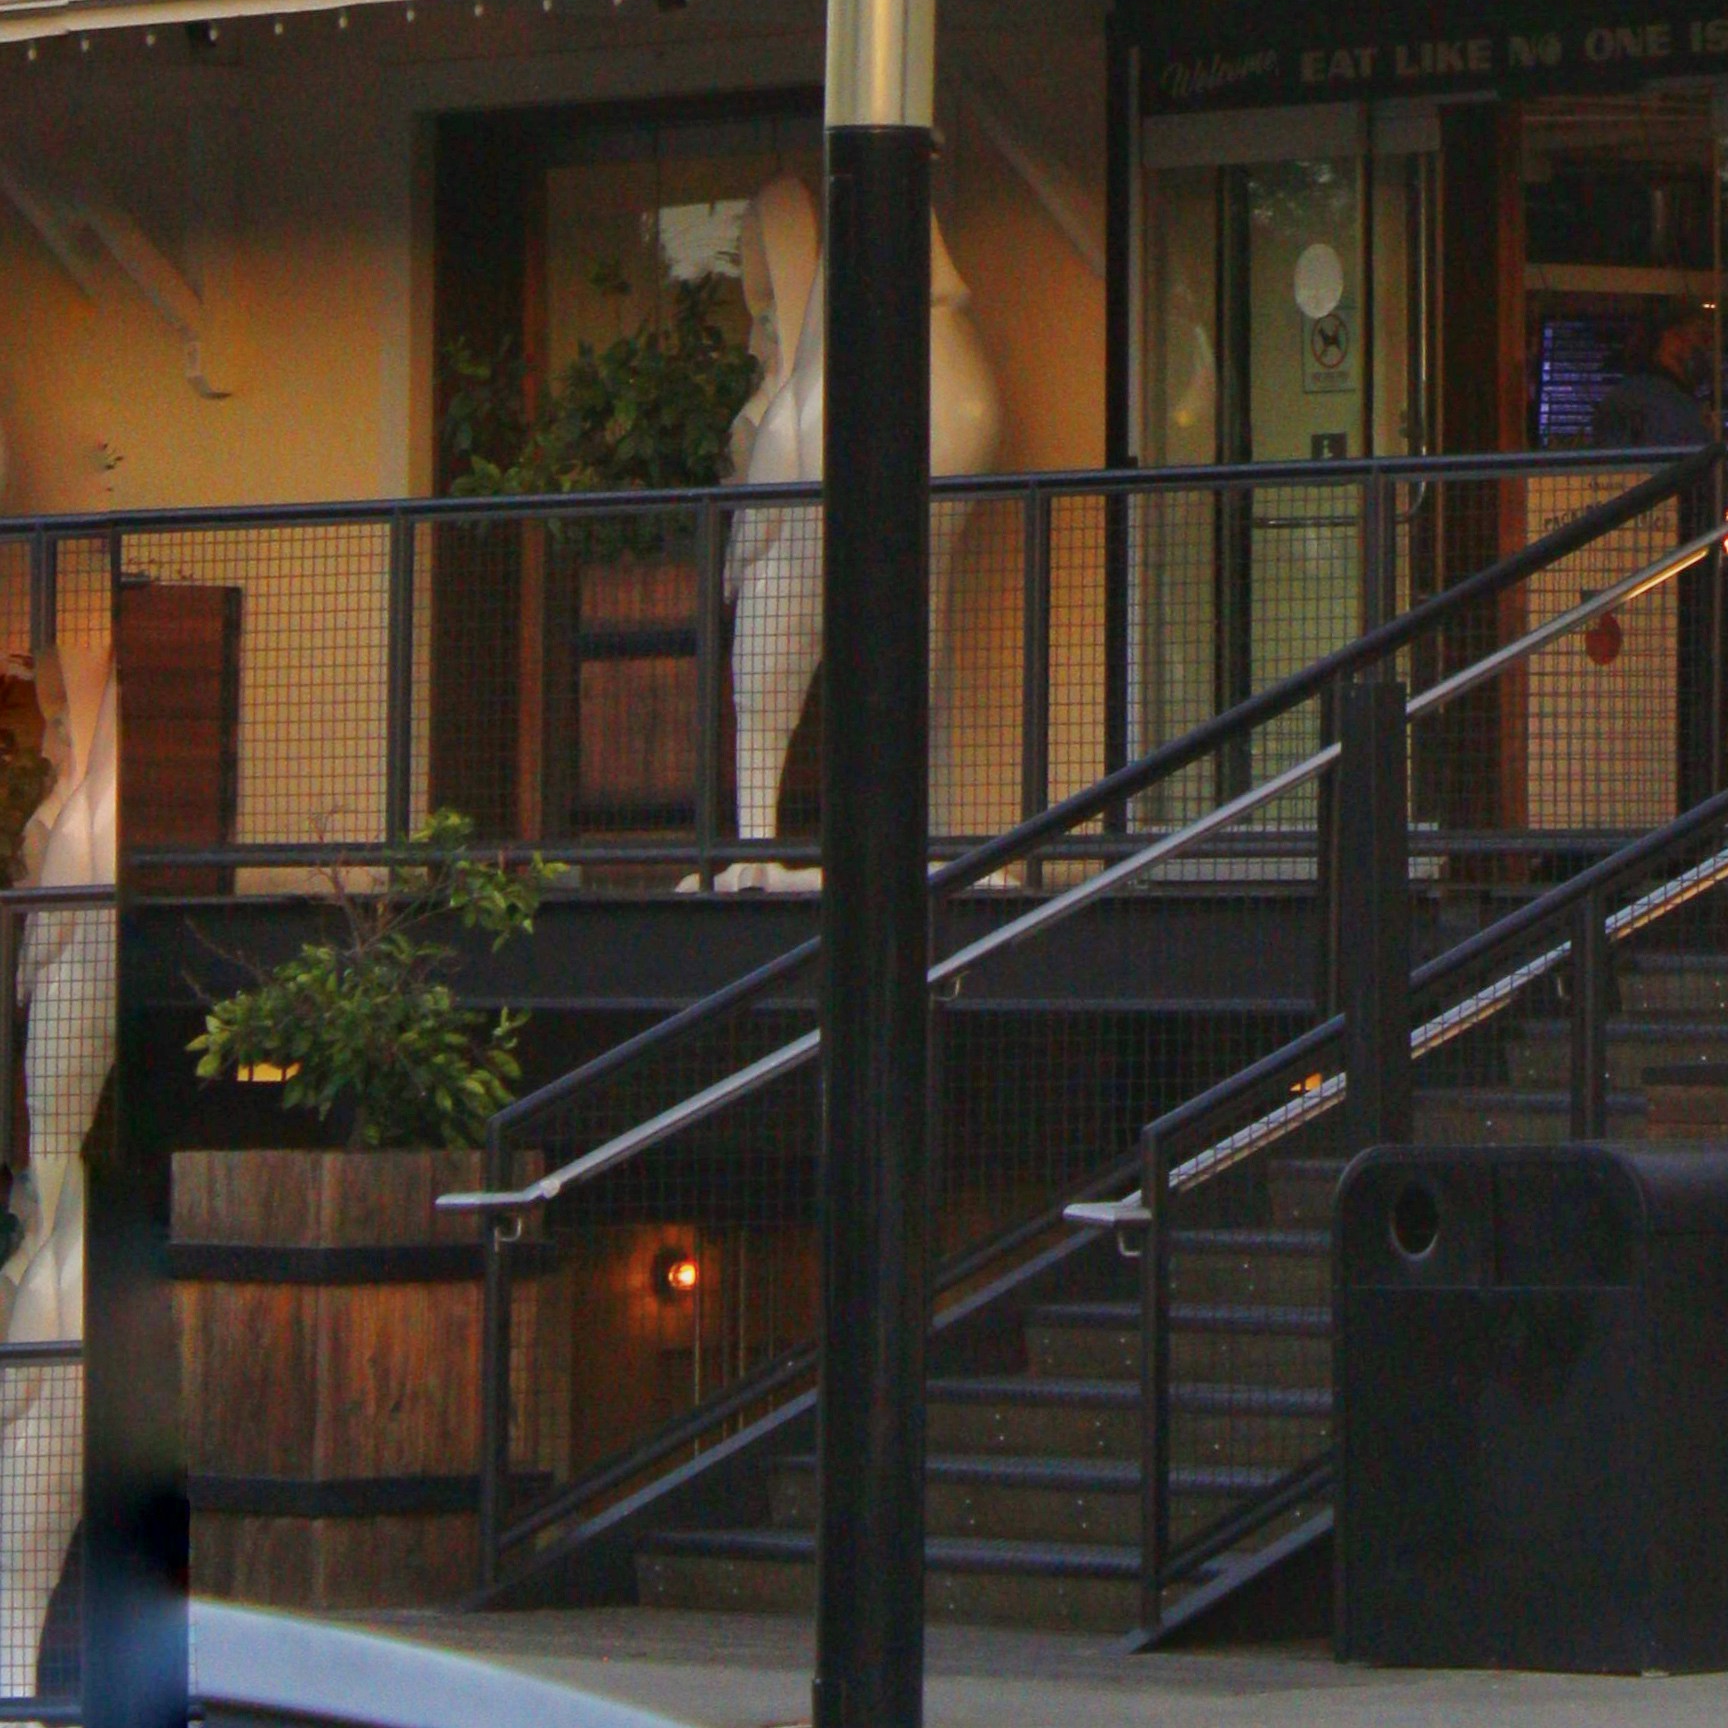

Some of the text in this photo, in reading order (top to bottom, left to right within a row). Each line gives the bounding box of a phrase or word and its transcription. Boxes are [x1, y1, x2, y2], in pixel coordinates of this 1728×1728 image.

[1300, 47, 1377, 82] EAT
[1395, 39, 1492, 76] LIKE
[1584, 24, 1671, 61] ONE
